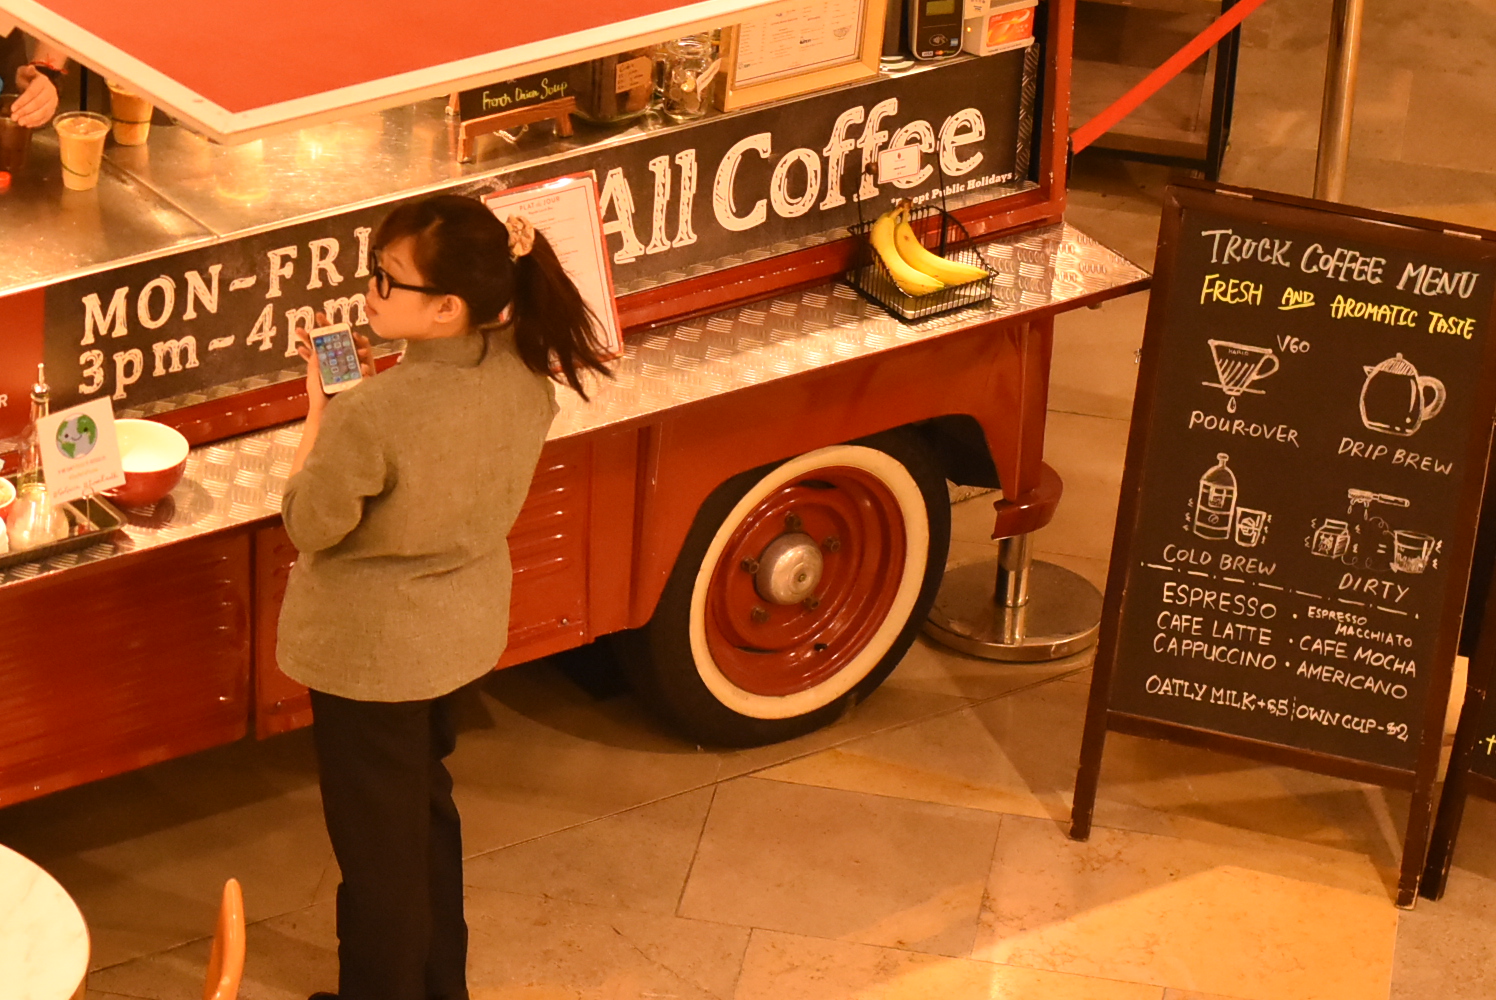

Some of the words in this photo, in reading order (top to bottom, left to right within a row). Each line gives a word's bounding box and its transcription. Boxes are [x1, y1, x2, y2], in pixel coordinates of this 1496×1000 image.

[540, 77, 568, 99] Soup
[599, 149, 698, 264] All
[712, 98, 986, 233] Coffee
[967, 172, 1013, 191] Holidays
[1201, 229, 1293, 267] TRUCK
[1300, 243, 1387, 285] COFFEE
[1396, 262, 1480, 299] MENU
[1200, 274, 1264, 306] FRESH
[1279, 287, 1315, 310] AND
[1330, 294, 1418, 328] AROMATIC
[1428, 311, 1477, 340] TASTE
[1188, 410, 1300, 449] POUR-OVER
[1338, 437, 1388, 461] DRIP
[1391, 448, 1453, 475] BREW
[1163, 543, 1212, 565] COLD
[1219, 553, 1276, 576] BREW
[1163, 581, 1277, 620] ESPRESSO
[1338, 572, 1410, 603] DIRTY
[1157, 611, 1203, 636] CAFE
[1212, 620, 1272, 645] LATTE
[1308, 606, 1367, 625] ESPRESSO
[1153, 632, 1277, 670] CAPPUCCINO
[1335, 623, 1413, 648] MACCHIATO
[1299, 635, 1348, 659] CAFE
[1353, 646, 1416, 678] MOCHA
[1145, 675, 1208, 701] OATLY
[1296, 660, 1408, 699] AMERICANO
[1296, 704, 1341, 726] OWN
